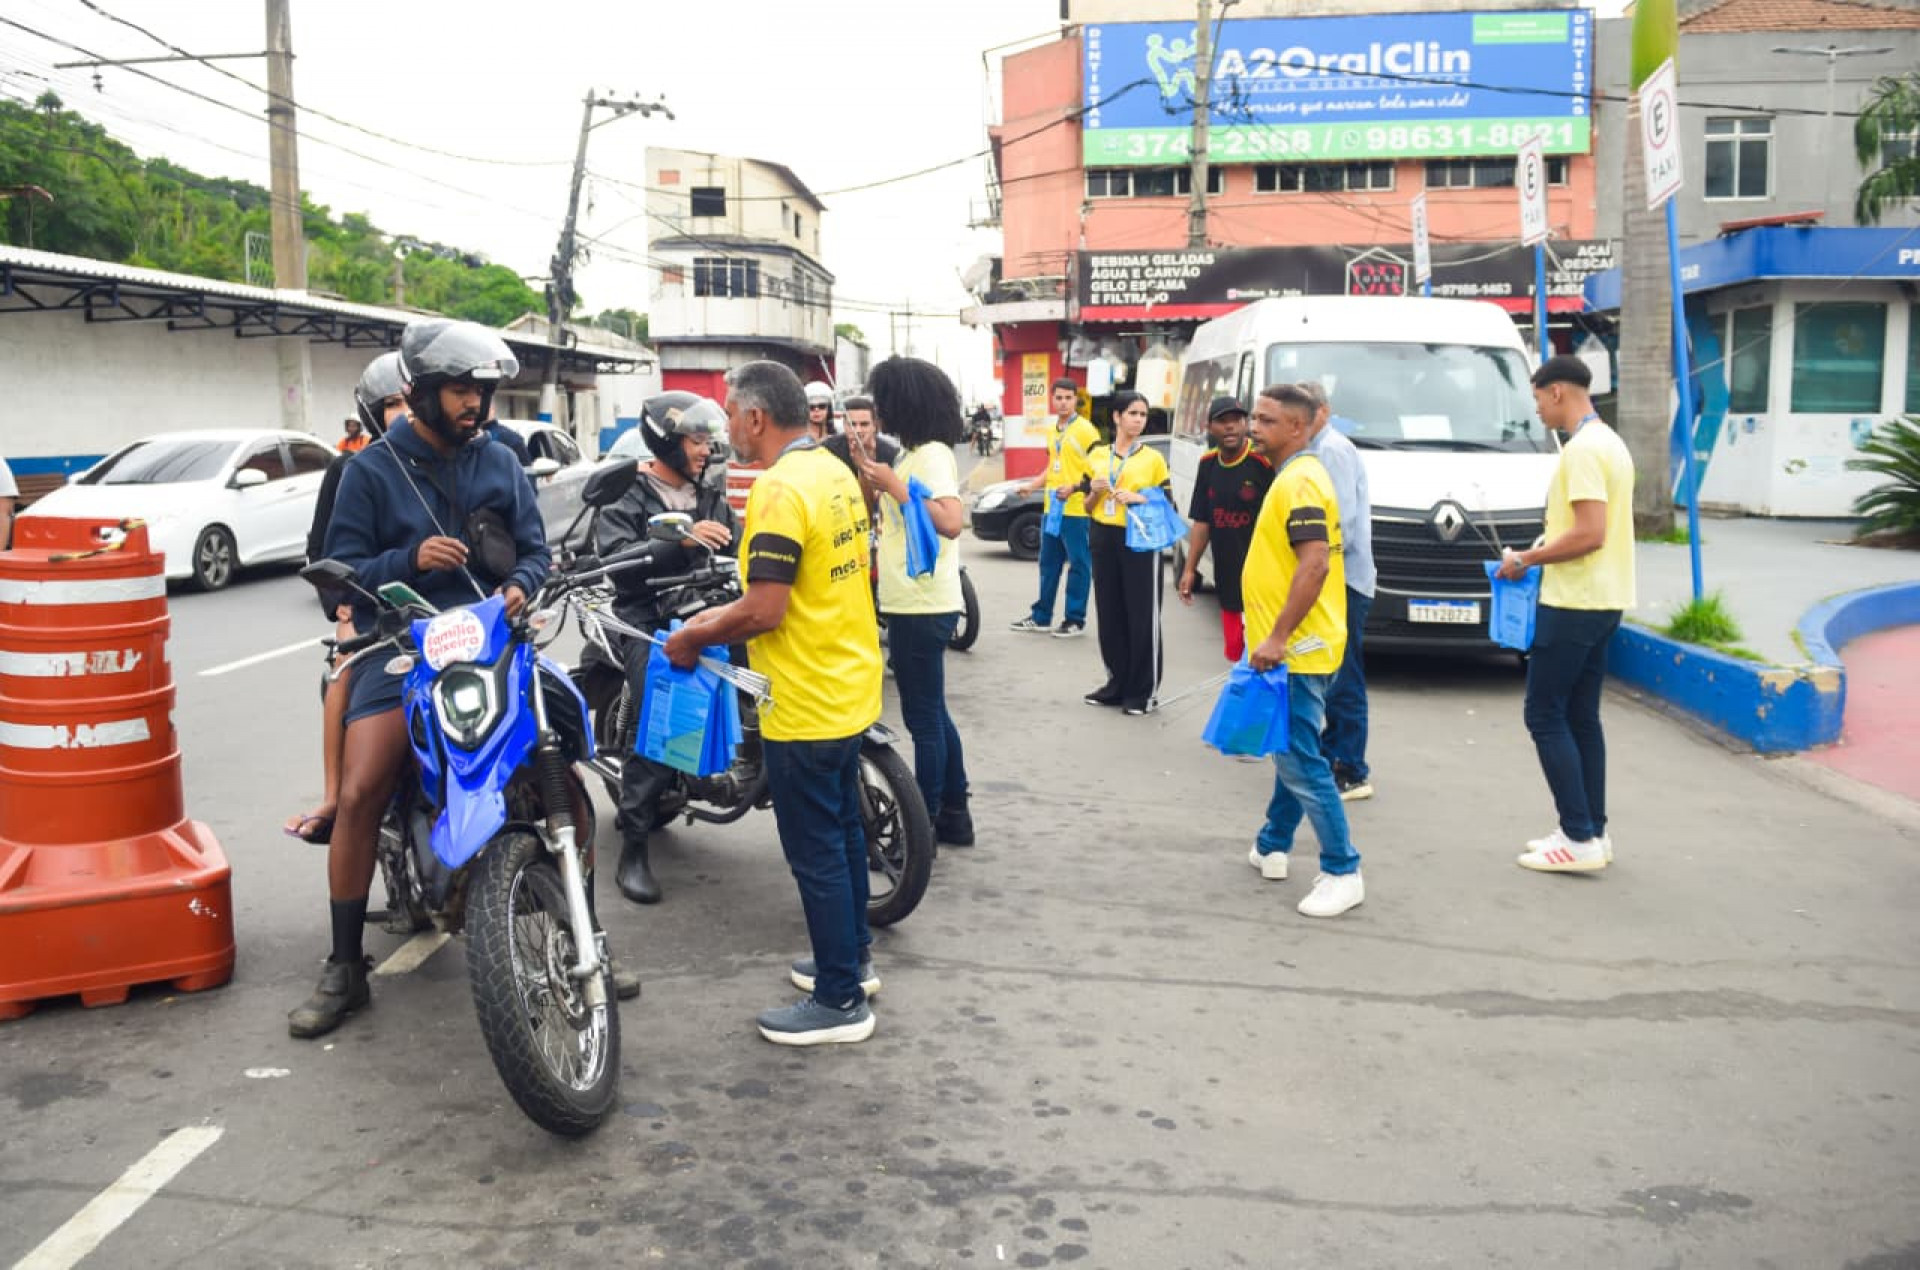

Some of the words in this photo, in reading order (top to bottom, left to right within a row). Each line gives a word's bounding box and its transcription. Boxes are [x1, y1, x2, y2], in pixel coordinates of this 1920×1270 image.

[1214, 42, 1471, 79] A2OralClin
[1652, 101, 1664, 137] E
[1126, 129, 1311, 157] 374-2568
[1091, 255, 1149, 268] BEBIDAS
[1151, 253, 1215, 265] GELADAS
[1133, 268, 1141, 279] E
[1091, 280, 1127, 292] GELO
[1091, 293, 1100, 304] E
